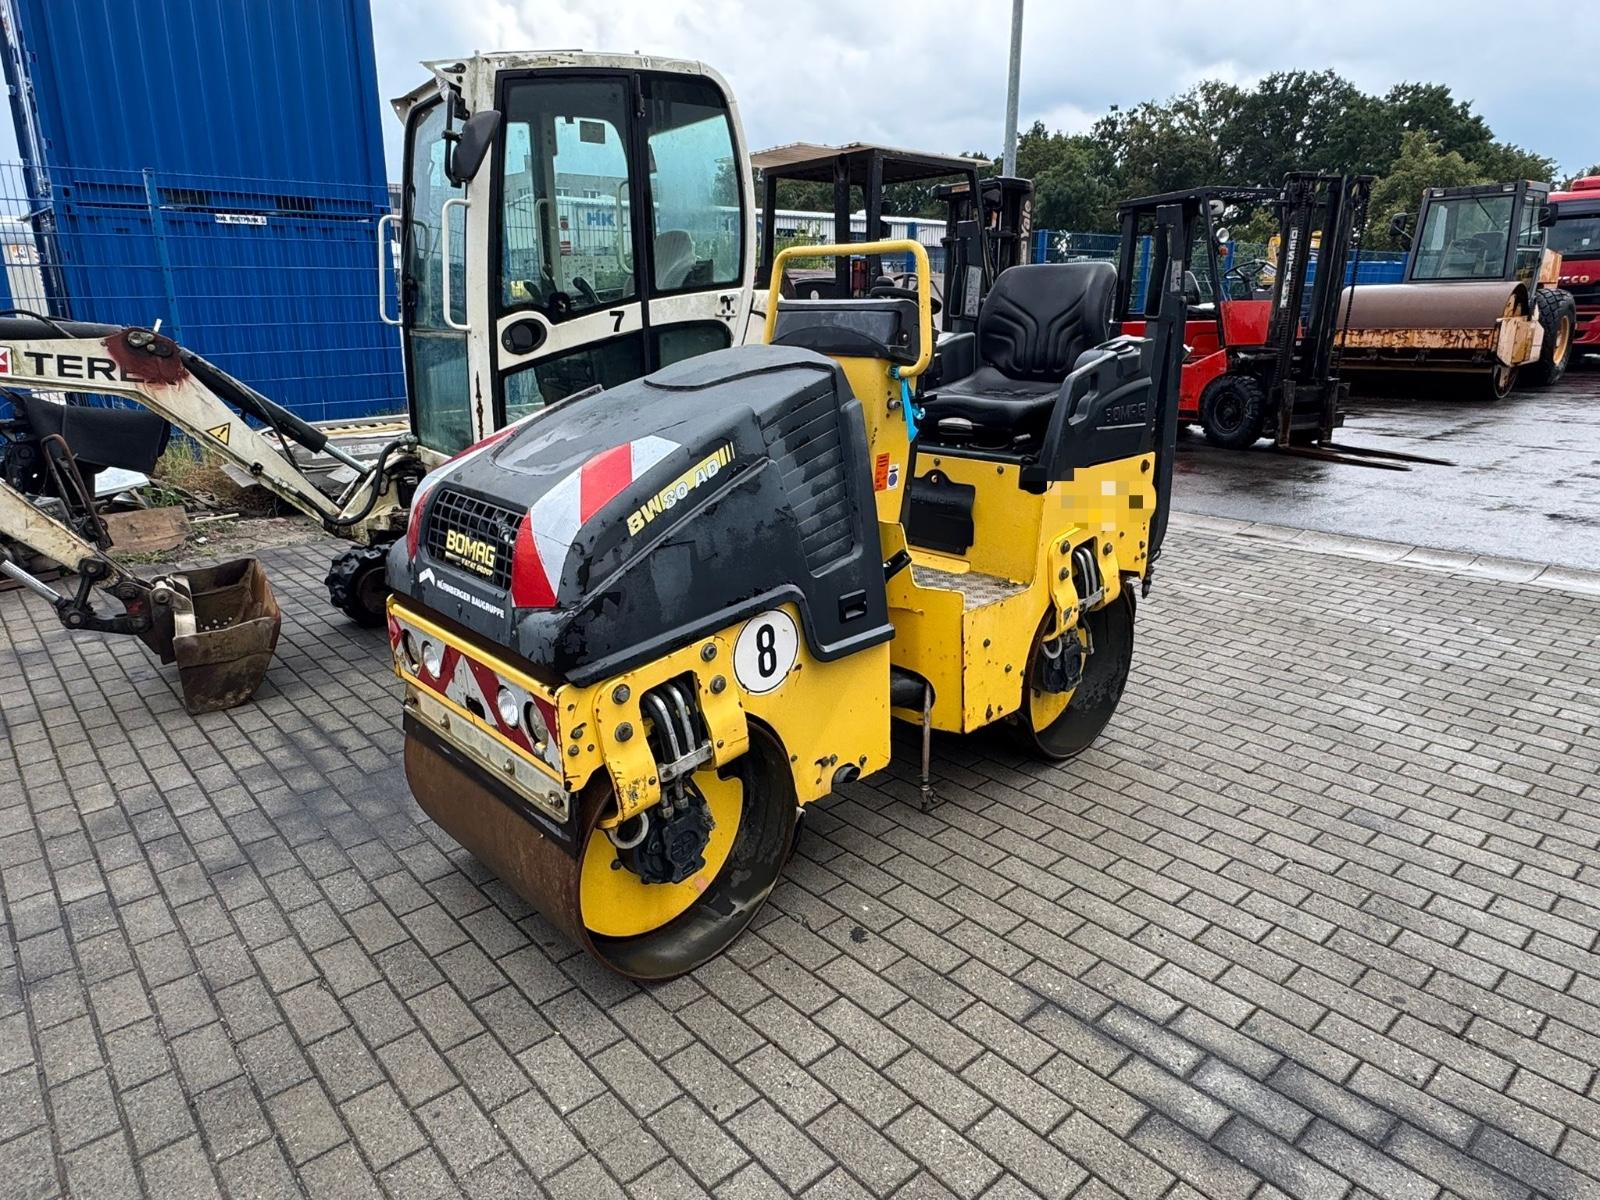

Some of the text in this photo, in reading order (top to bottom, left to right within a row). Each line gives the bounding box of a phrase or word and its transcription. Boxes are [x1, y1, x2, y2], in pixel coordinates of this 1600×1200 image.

[586, 211, 626, 227] HK
[609, 310, 625, 333] 7
[445, 529, 496, 568] BOMAG
[471, 595, 505, 619] BAUGRUPPE
[756, 623, 777, 678] 8
